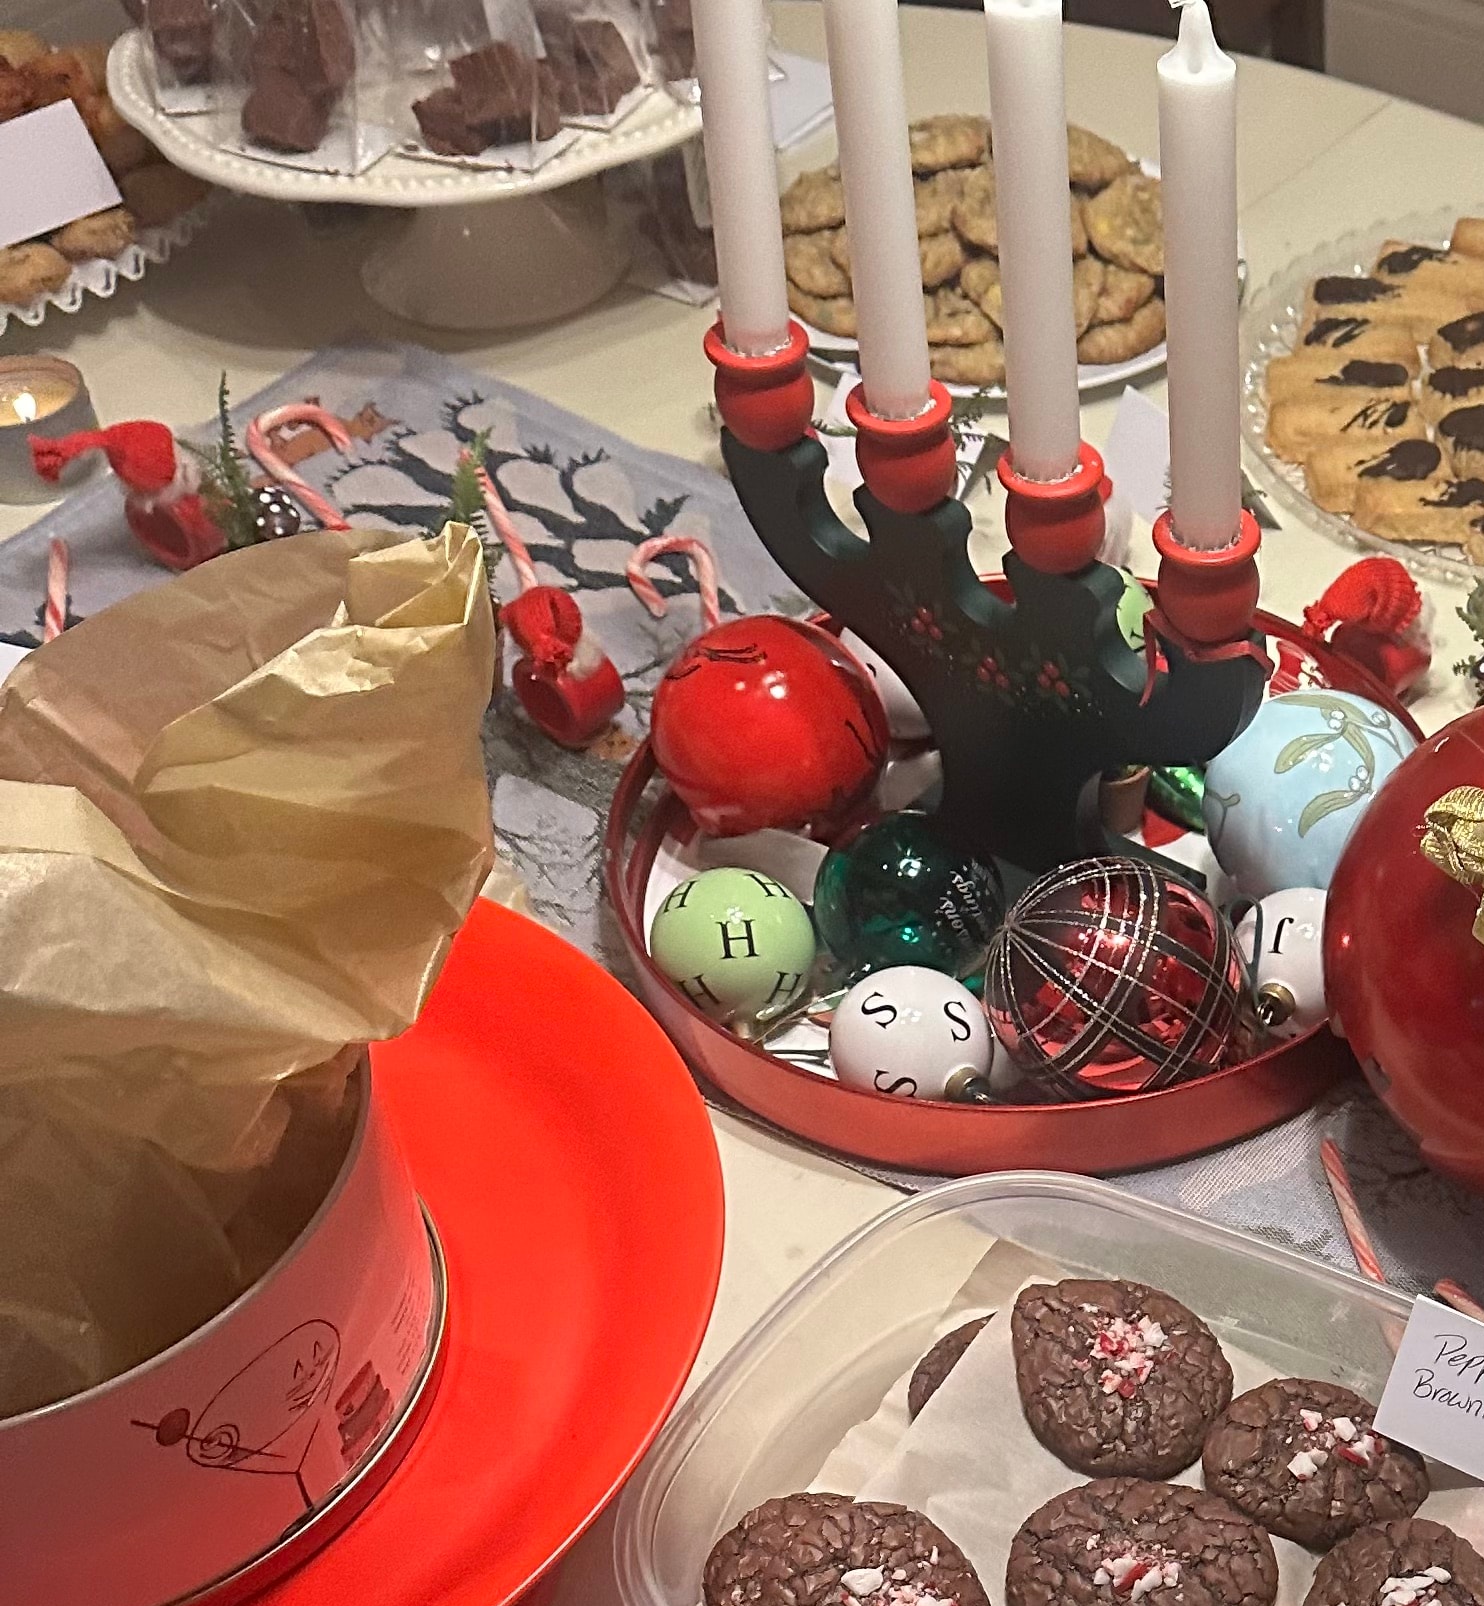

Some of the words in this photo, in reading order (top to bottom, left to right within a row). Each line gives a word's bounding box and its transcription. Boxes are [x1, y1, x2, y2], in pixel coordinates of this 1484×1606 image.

[663, 880, 697, 914] H
[744, 873, 792, 900] H
[715, 919, 760, 960] H
[1267, 917, 1295, 955] J
[766, 971, 803, 1005] H
[861, 991, 898, 1029] S
[943, 1001, 972, 1042] S
